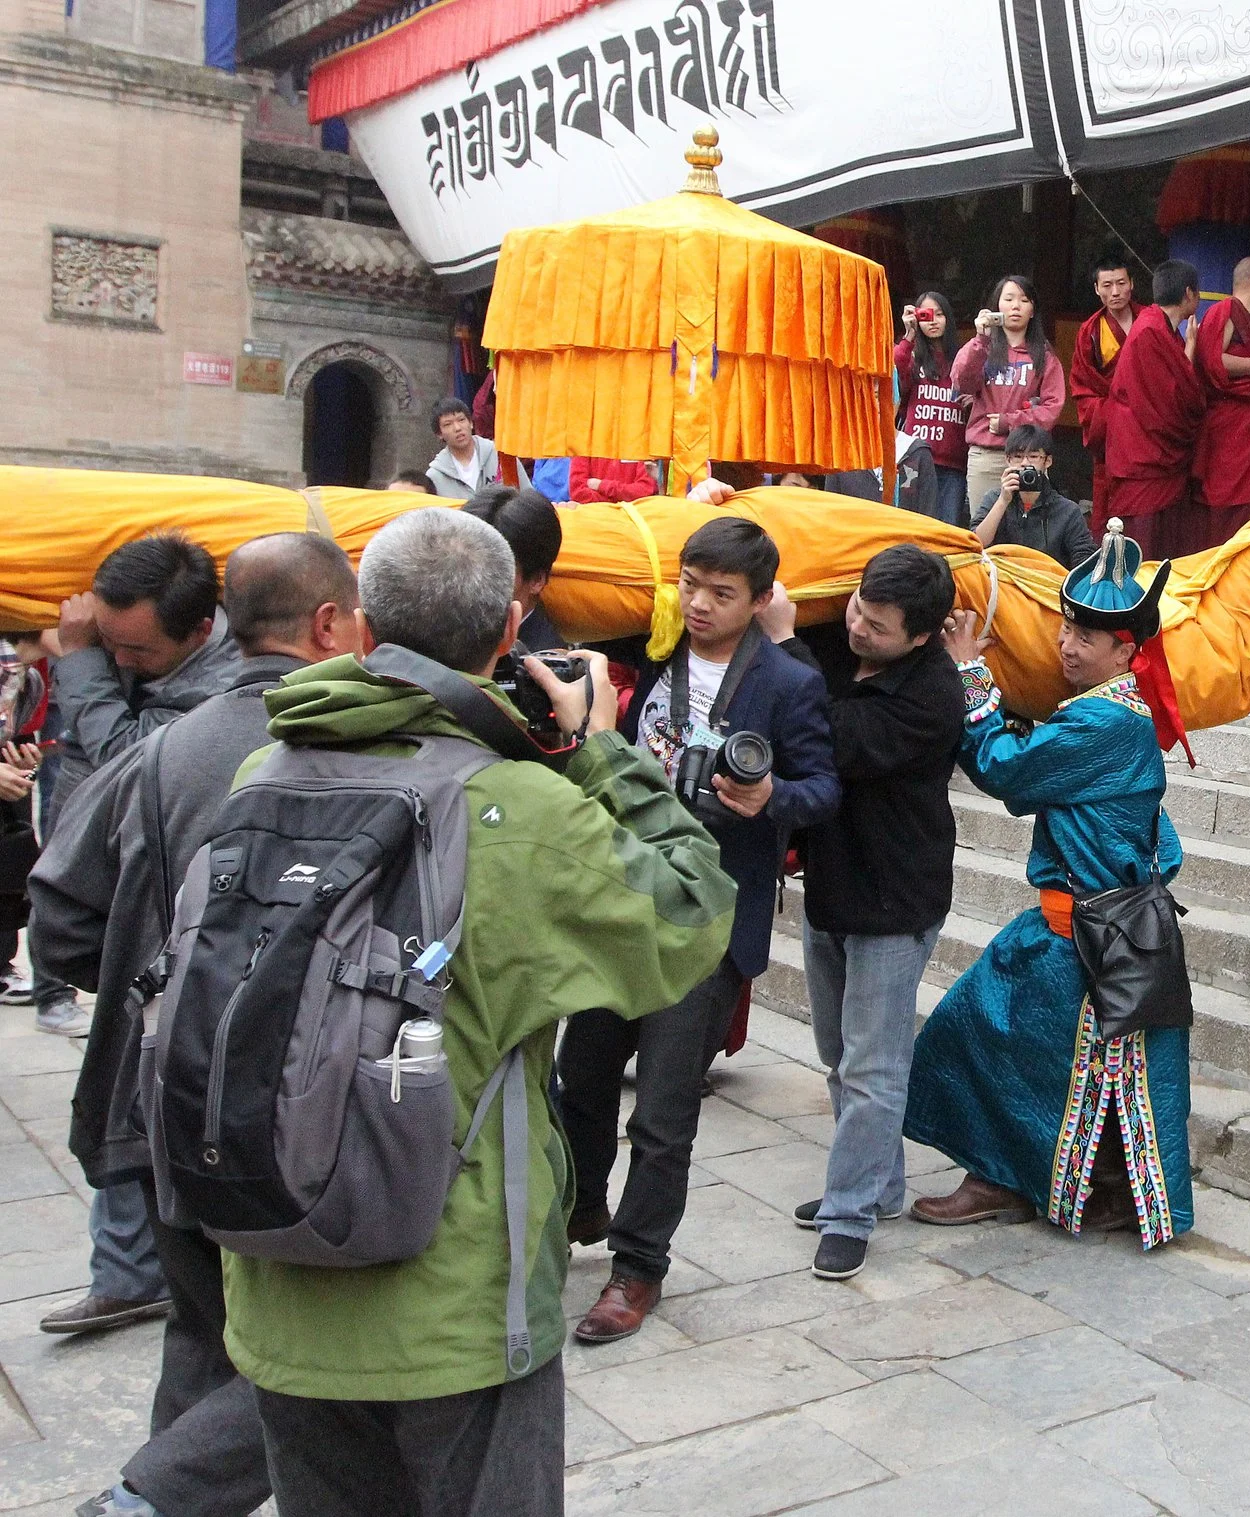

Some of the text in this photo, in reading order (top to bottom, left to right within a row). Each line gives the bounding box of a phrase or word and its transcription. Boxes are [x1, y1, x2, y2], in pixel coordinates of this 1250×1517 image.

[918, 385, 956, 402] PUDON
[912, 424, 944, 441] 2013
[691, 688, 715, 702] AFTERNOO
